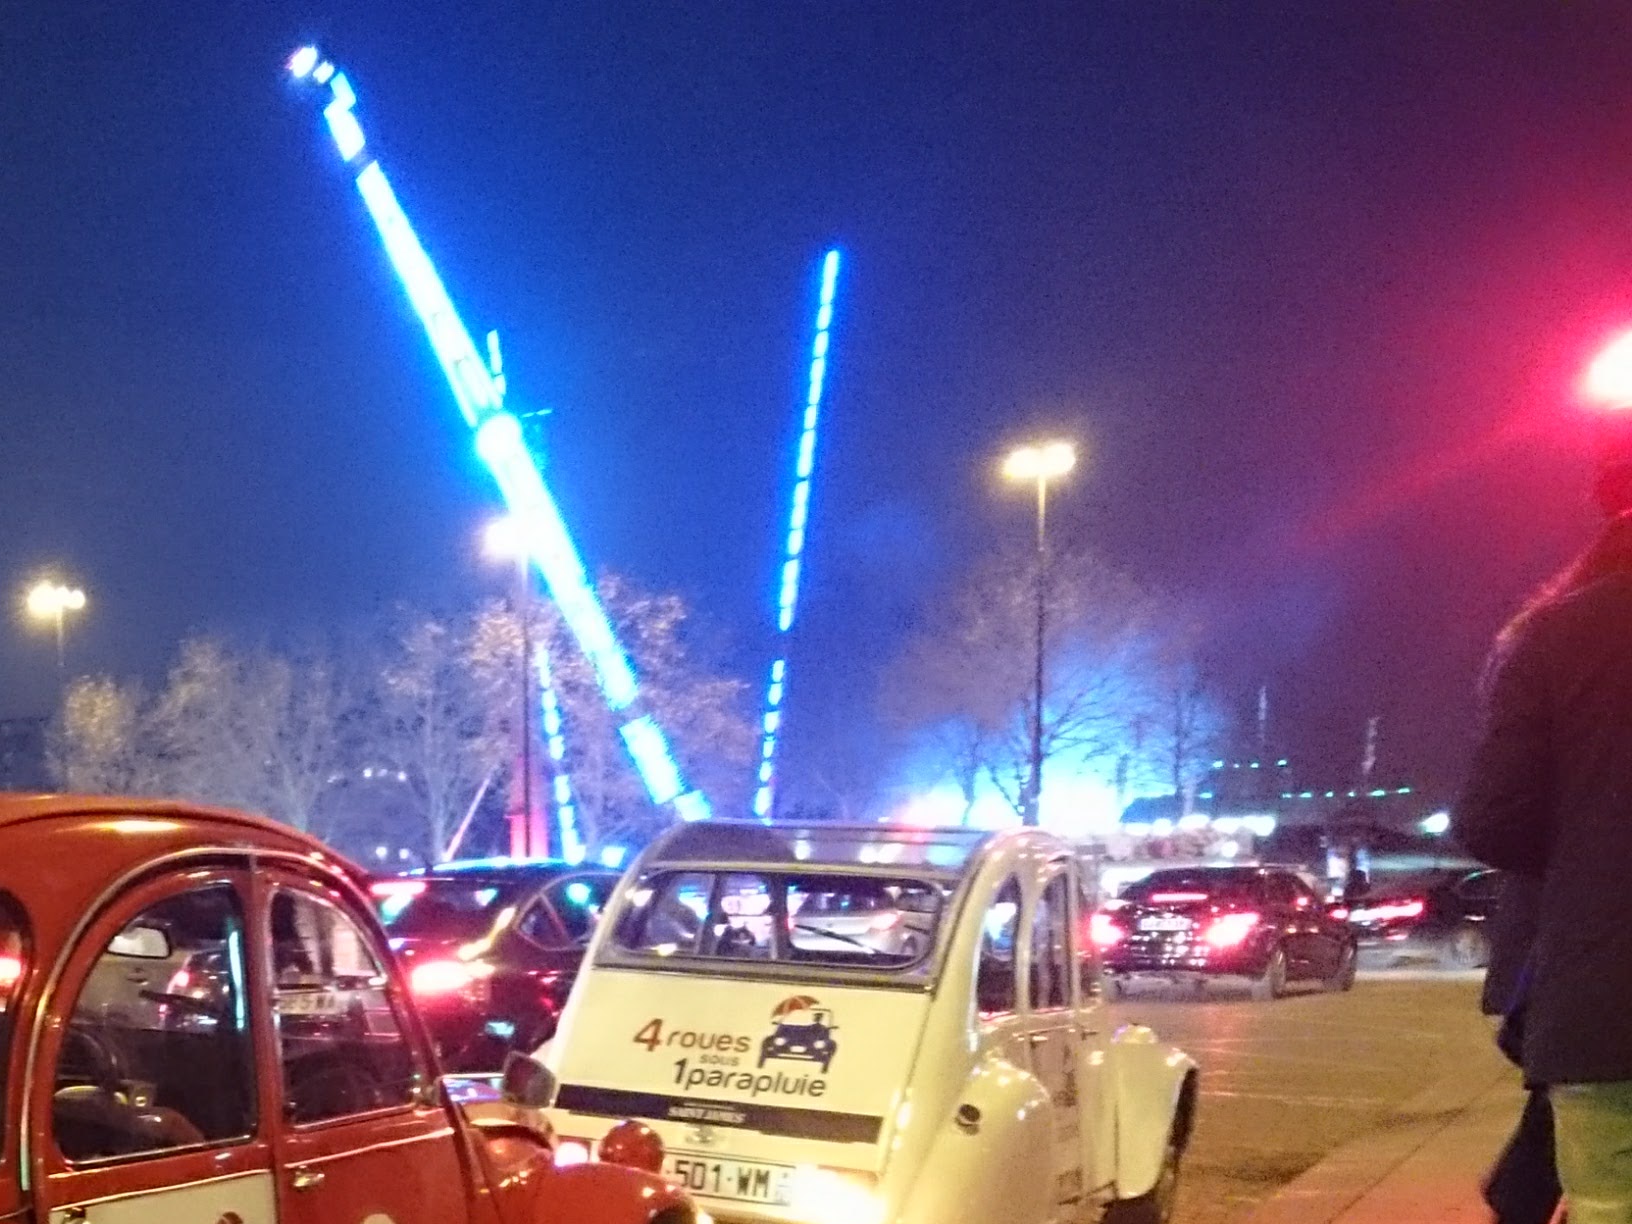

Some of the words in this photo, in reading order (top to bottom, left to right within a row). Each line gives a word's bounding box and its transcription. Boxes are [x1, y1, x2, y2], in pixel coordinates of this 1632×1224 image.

[632, 1017, 664, 1052] 4
[667, 1029, 752, 1053] roues
[698, 1053, 740, 1068] sous
